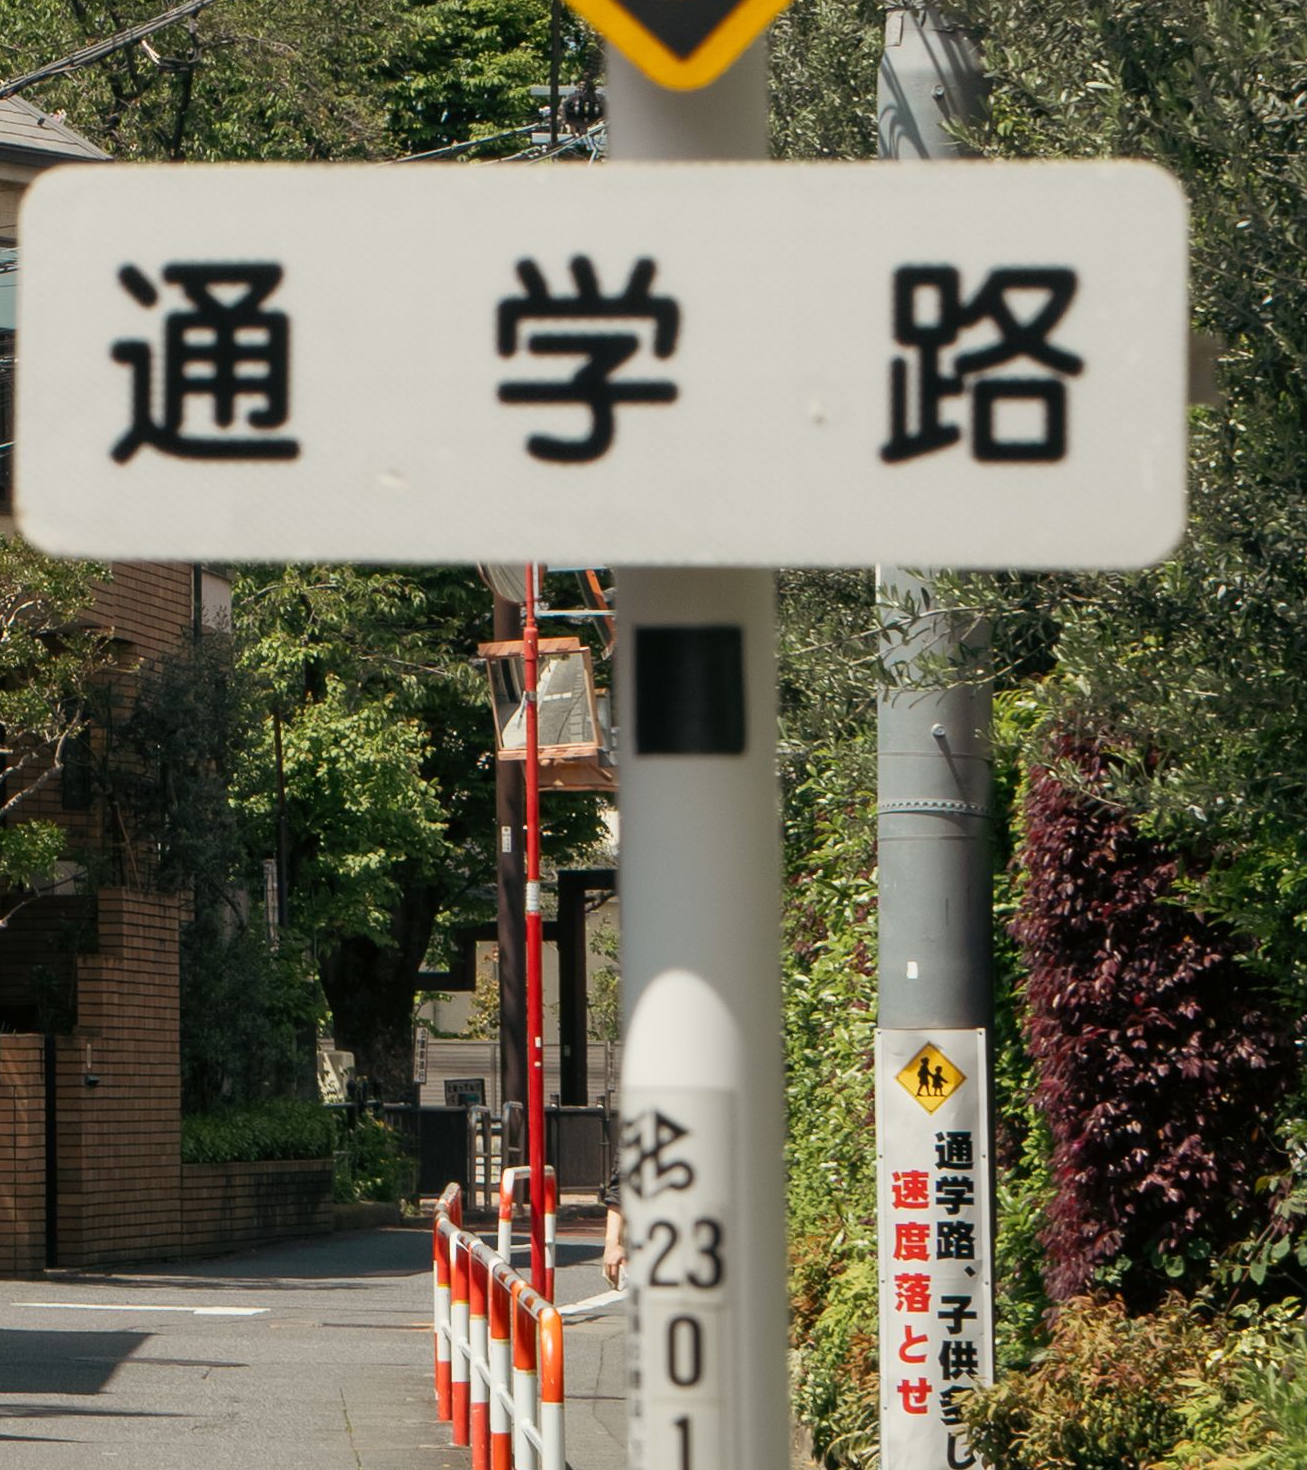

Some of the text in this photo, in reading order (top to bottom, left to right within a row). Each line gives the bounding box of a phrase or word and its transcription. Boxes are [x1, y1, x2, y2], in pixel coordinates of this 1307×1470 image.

[109, 254, 1086, 463] 通学路
[891, 1170, 933, 1415] 速度落とせ
